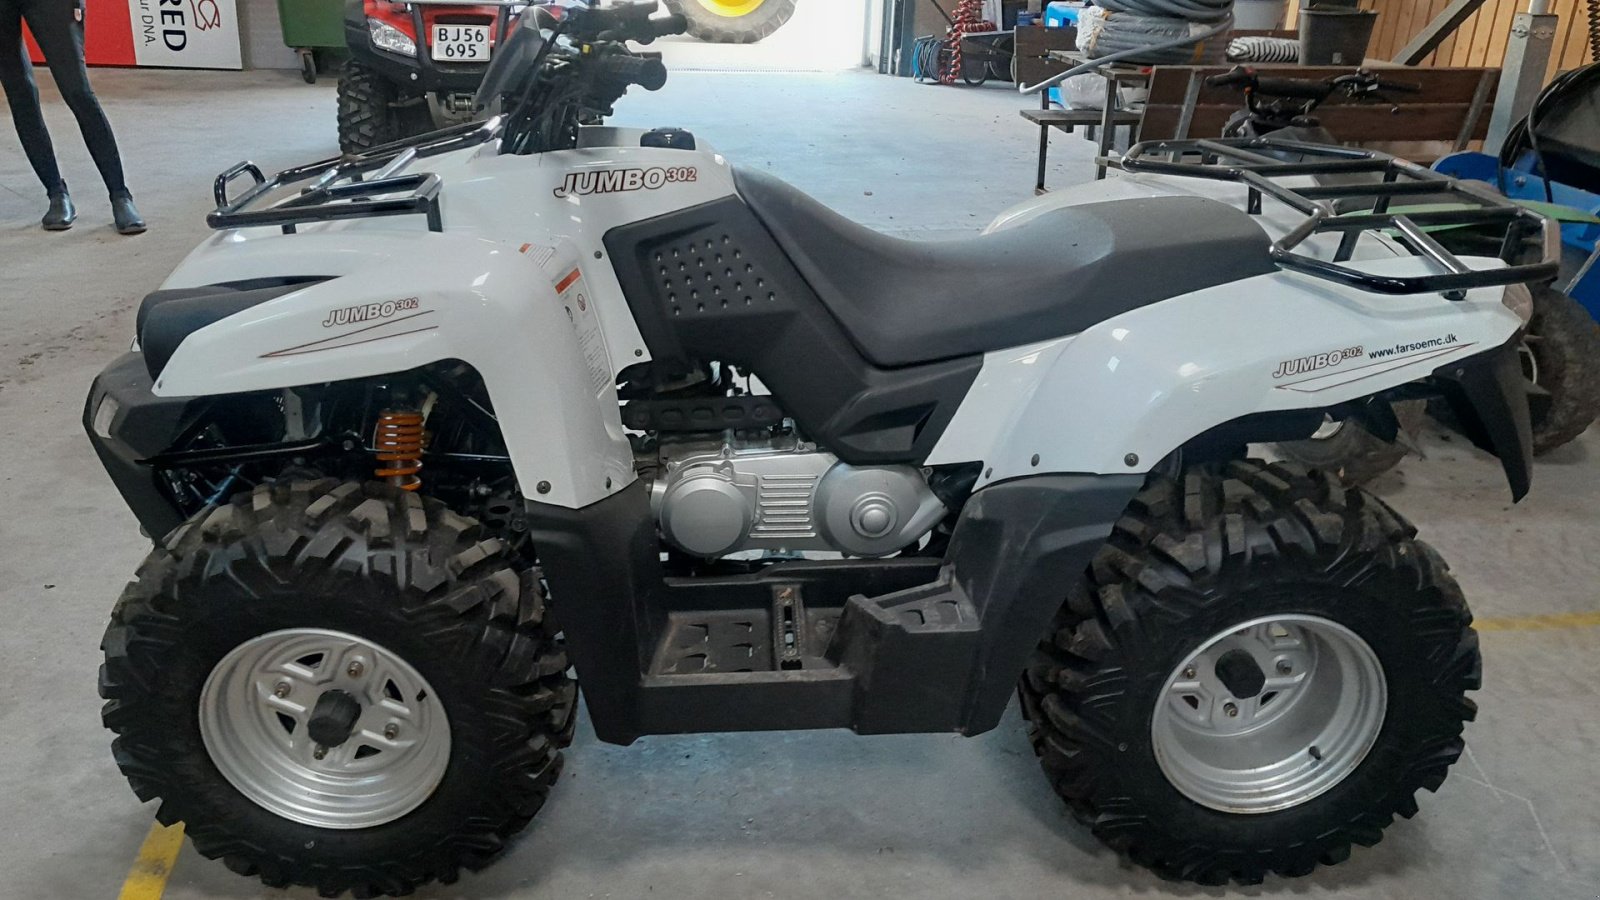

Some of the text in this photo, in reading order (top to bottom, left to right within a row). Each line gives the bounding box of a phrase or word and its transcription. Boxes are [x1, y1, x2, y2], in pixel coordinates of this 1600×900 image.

[141, 15, 156, 47] DNA.
[438, 28, 484, 43] BJ56
[445, 44, 477, 58] 695
[1368, 333, 1458, 359] www.farsoemc.dk
